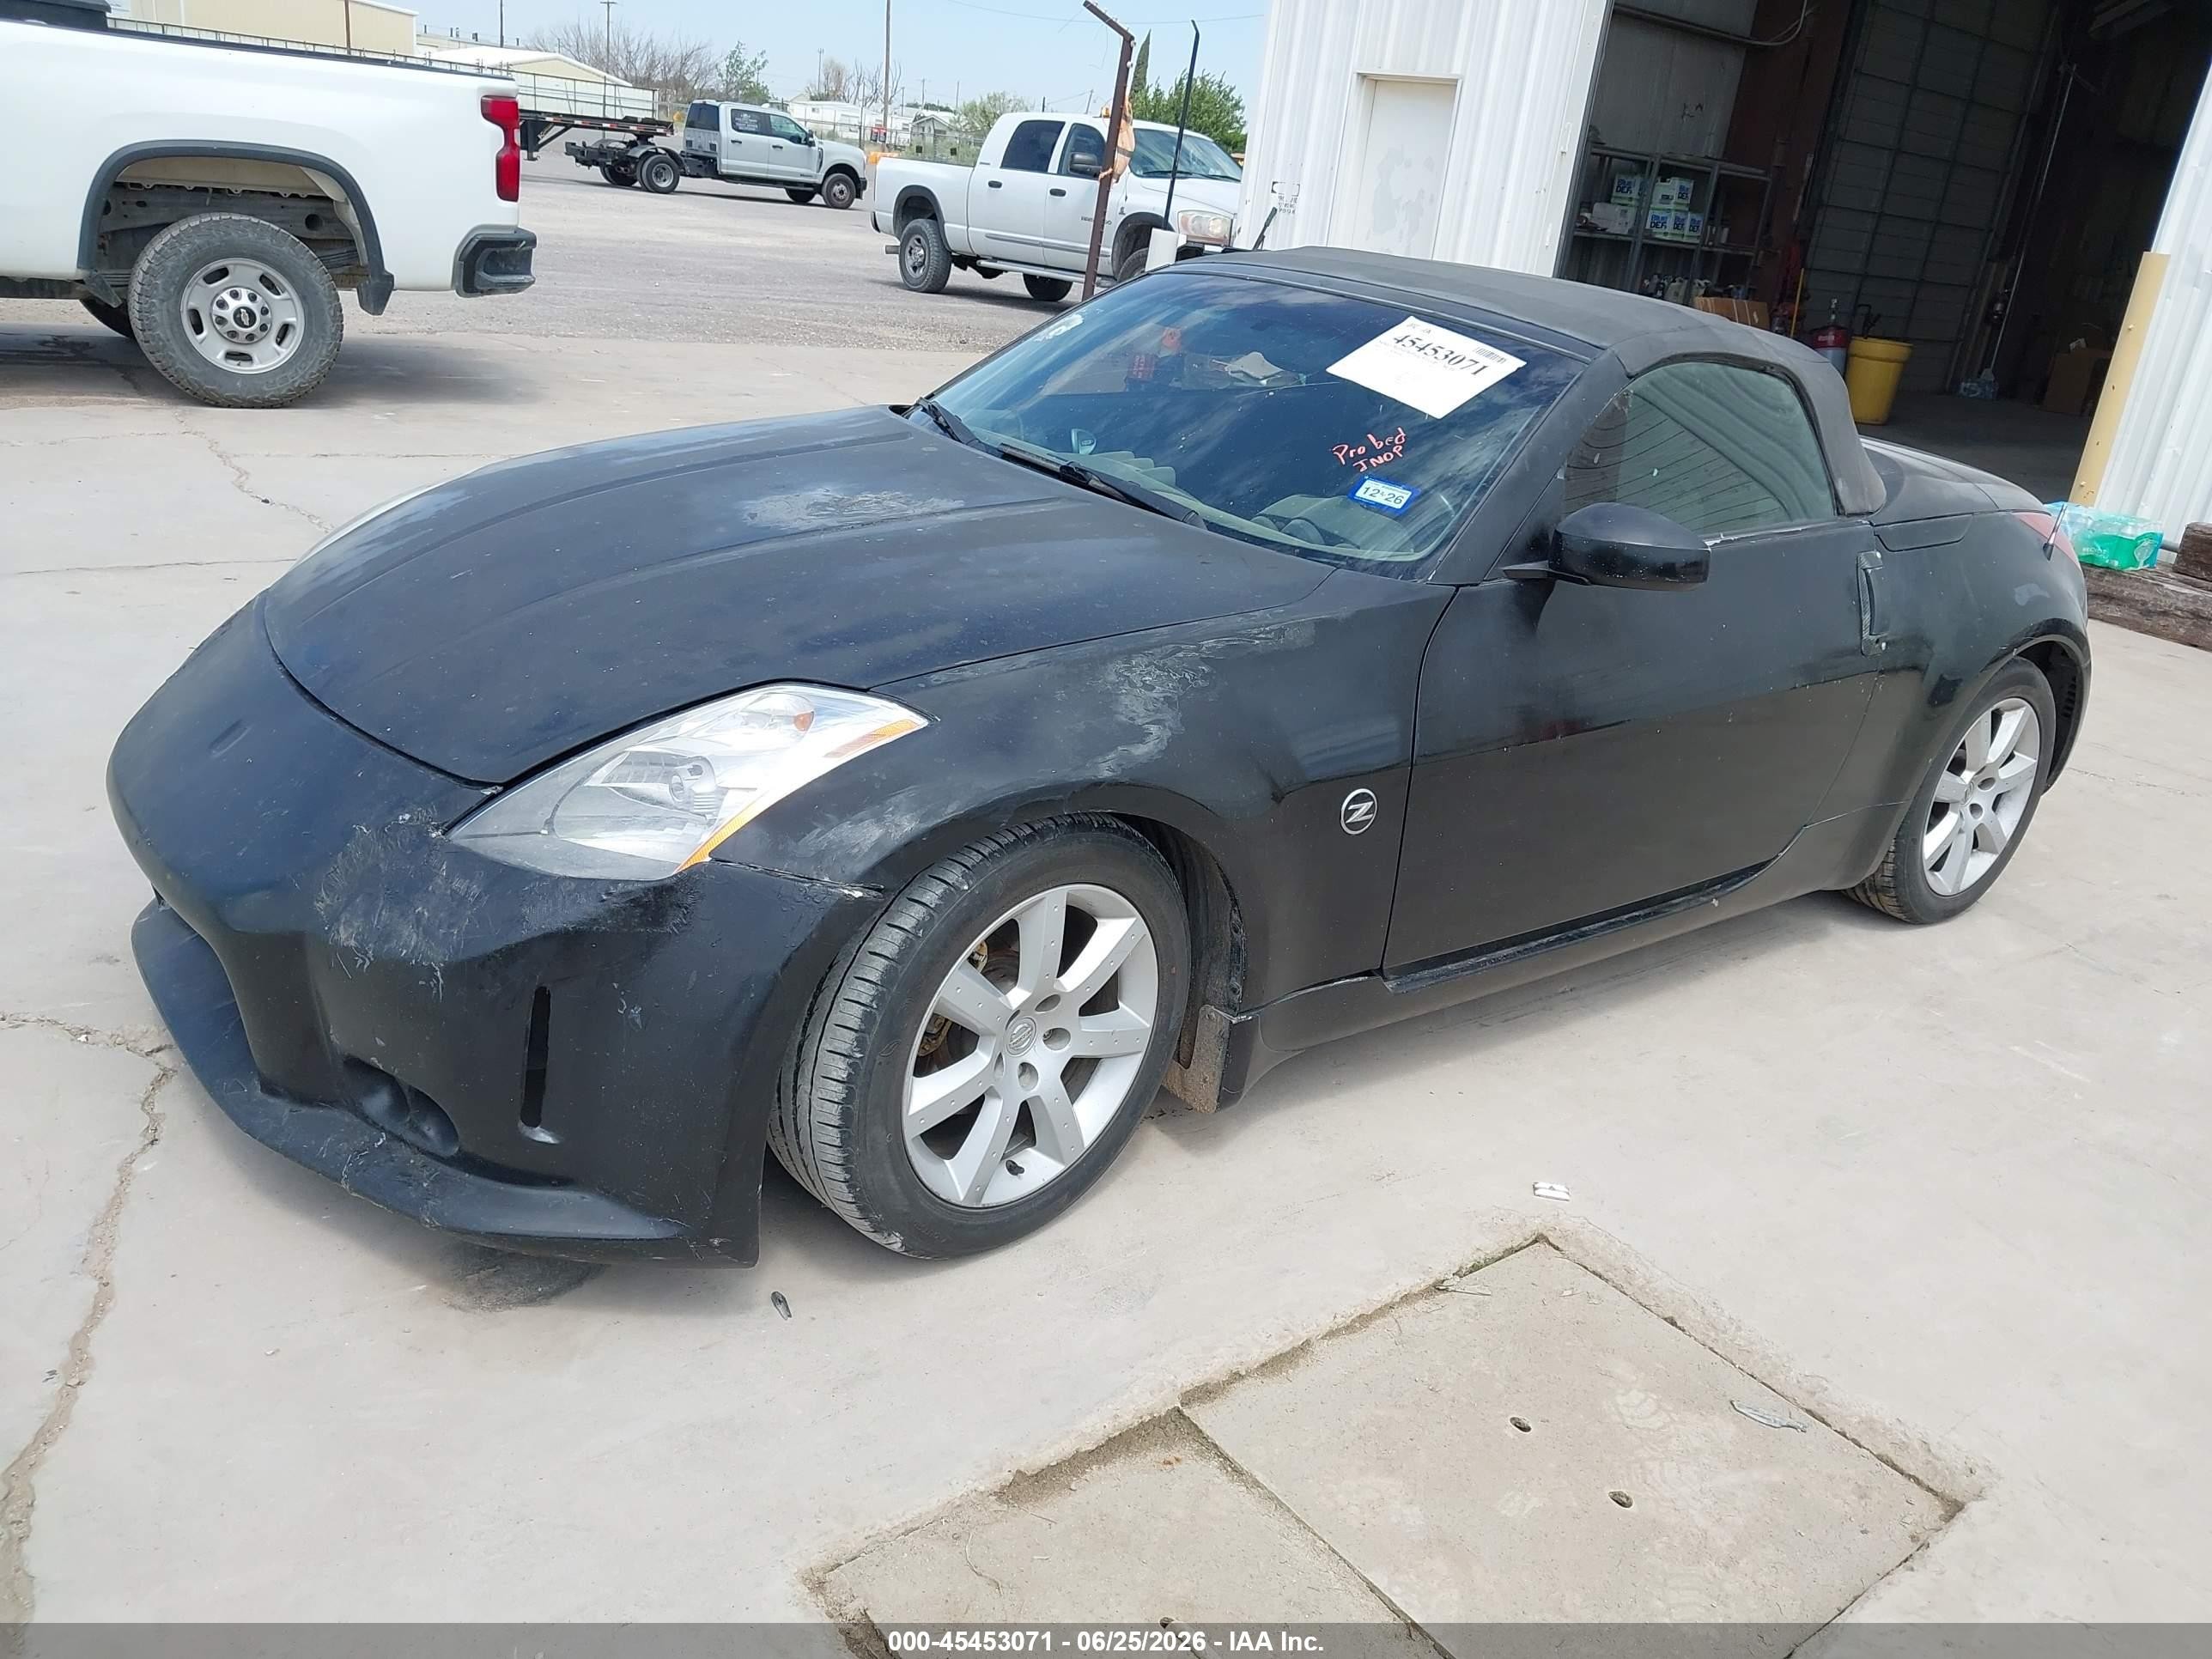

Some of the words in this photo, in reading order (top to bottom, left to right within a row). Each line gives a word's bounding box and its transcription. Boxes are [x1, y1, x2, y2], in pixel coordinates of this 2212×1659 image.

[1393, 334, 1489, 376] 45453071
[1332, 444, 1366, 465] Pro
[1346, 800, 1374, 824] Z
